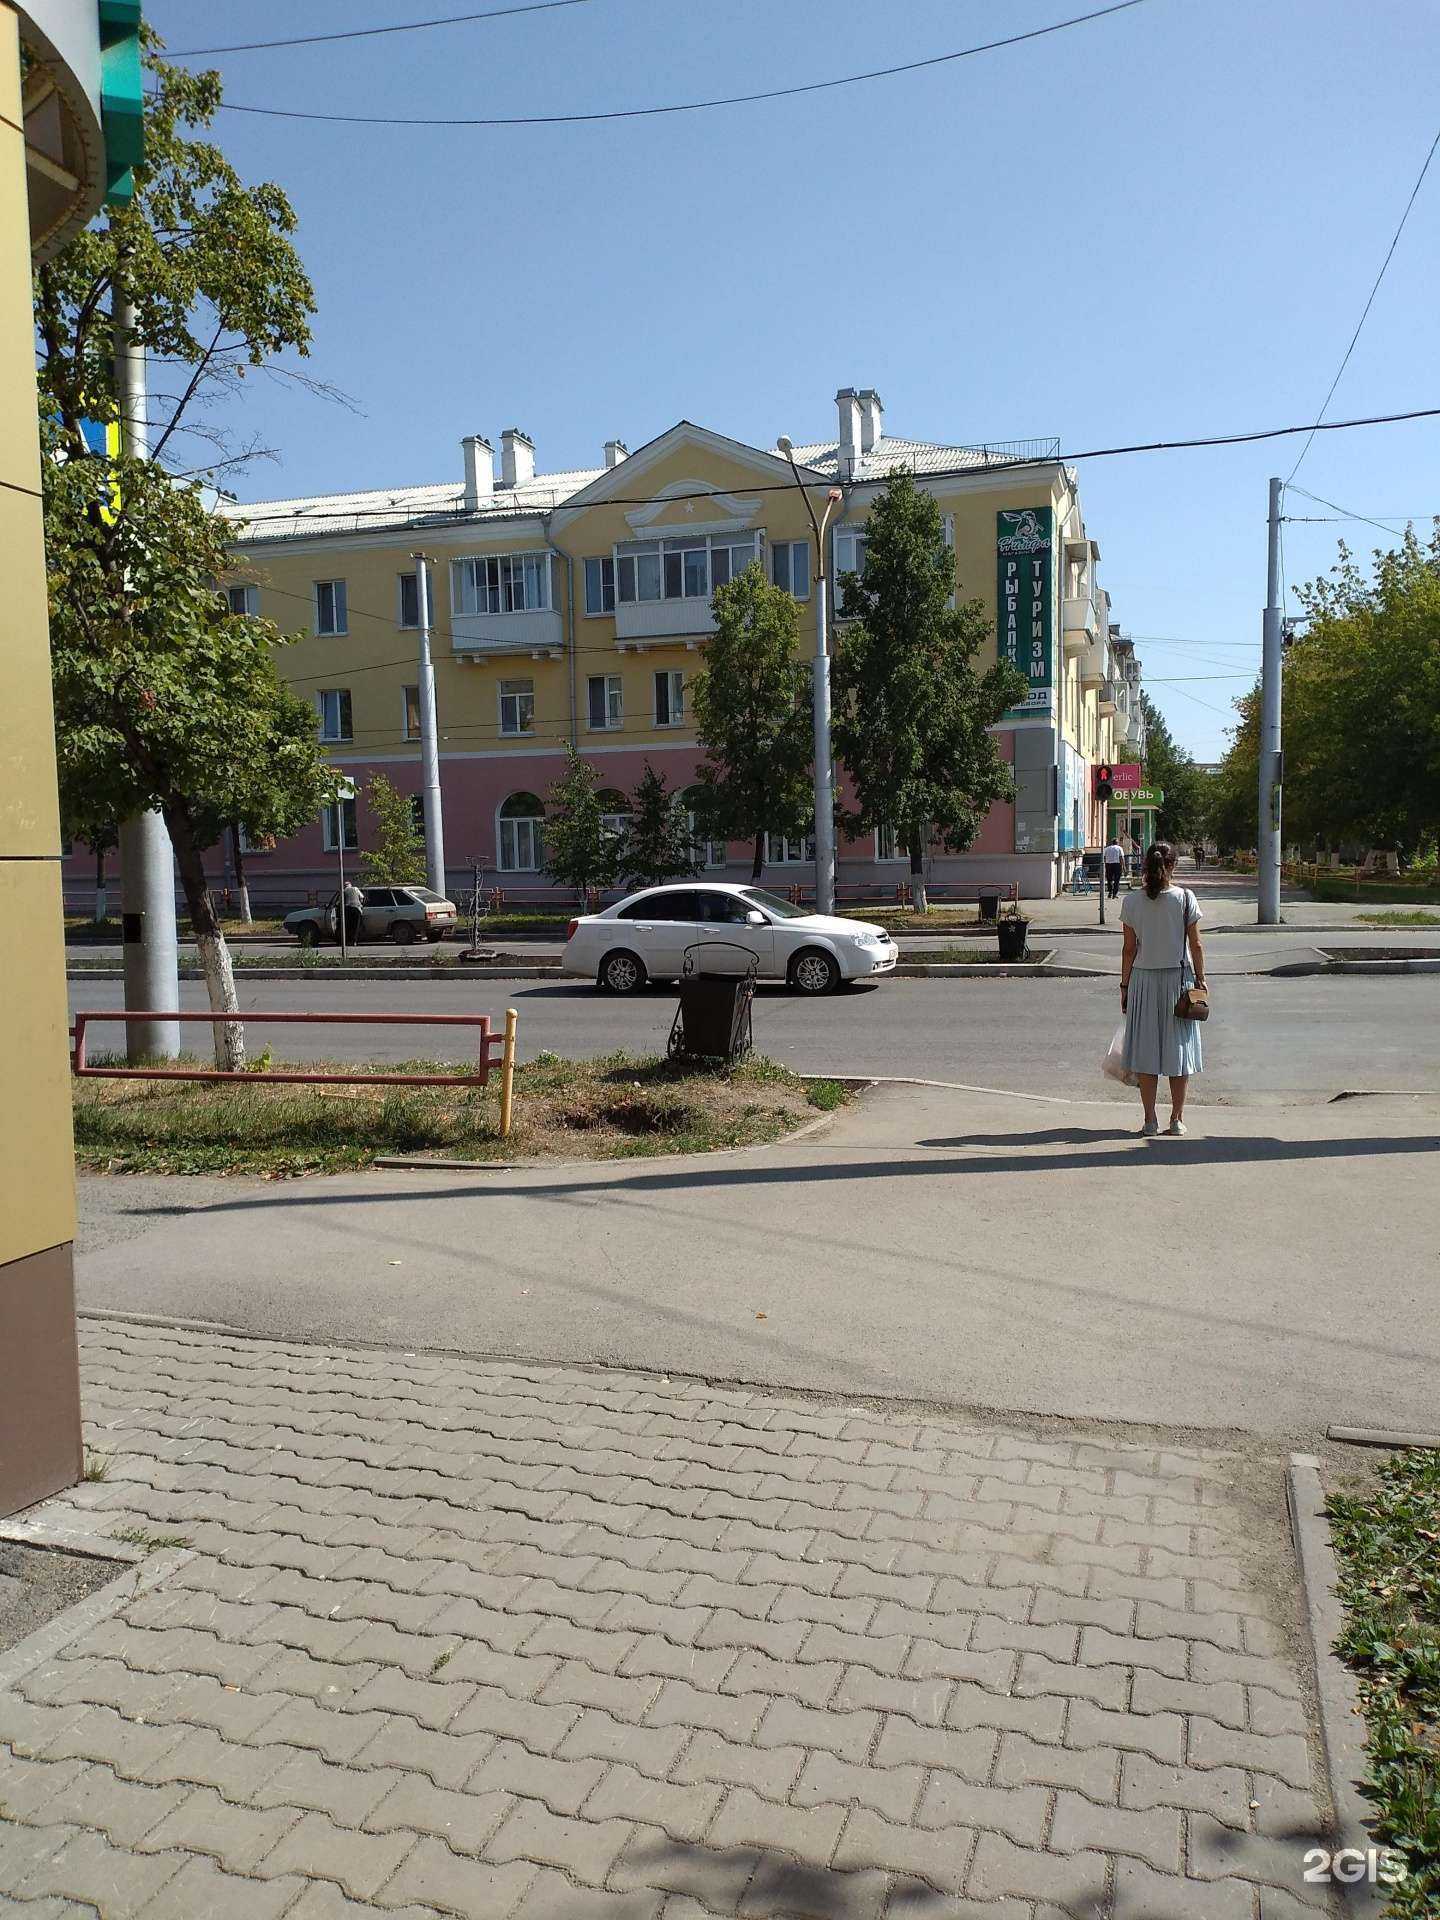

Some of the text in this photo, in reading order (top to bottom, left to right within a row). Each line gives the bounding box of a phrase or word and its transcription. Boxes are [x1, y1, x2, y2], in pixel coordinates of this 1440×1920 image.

[1005, 562, 1019, 663] РЫБАЛК
[1030, 560, 1045, 677] ТУРИЗМ
[1113, 772, 1133, 781] erlic
[1114, 790, 1154, 800] ОБУВЬ
